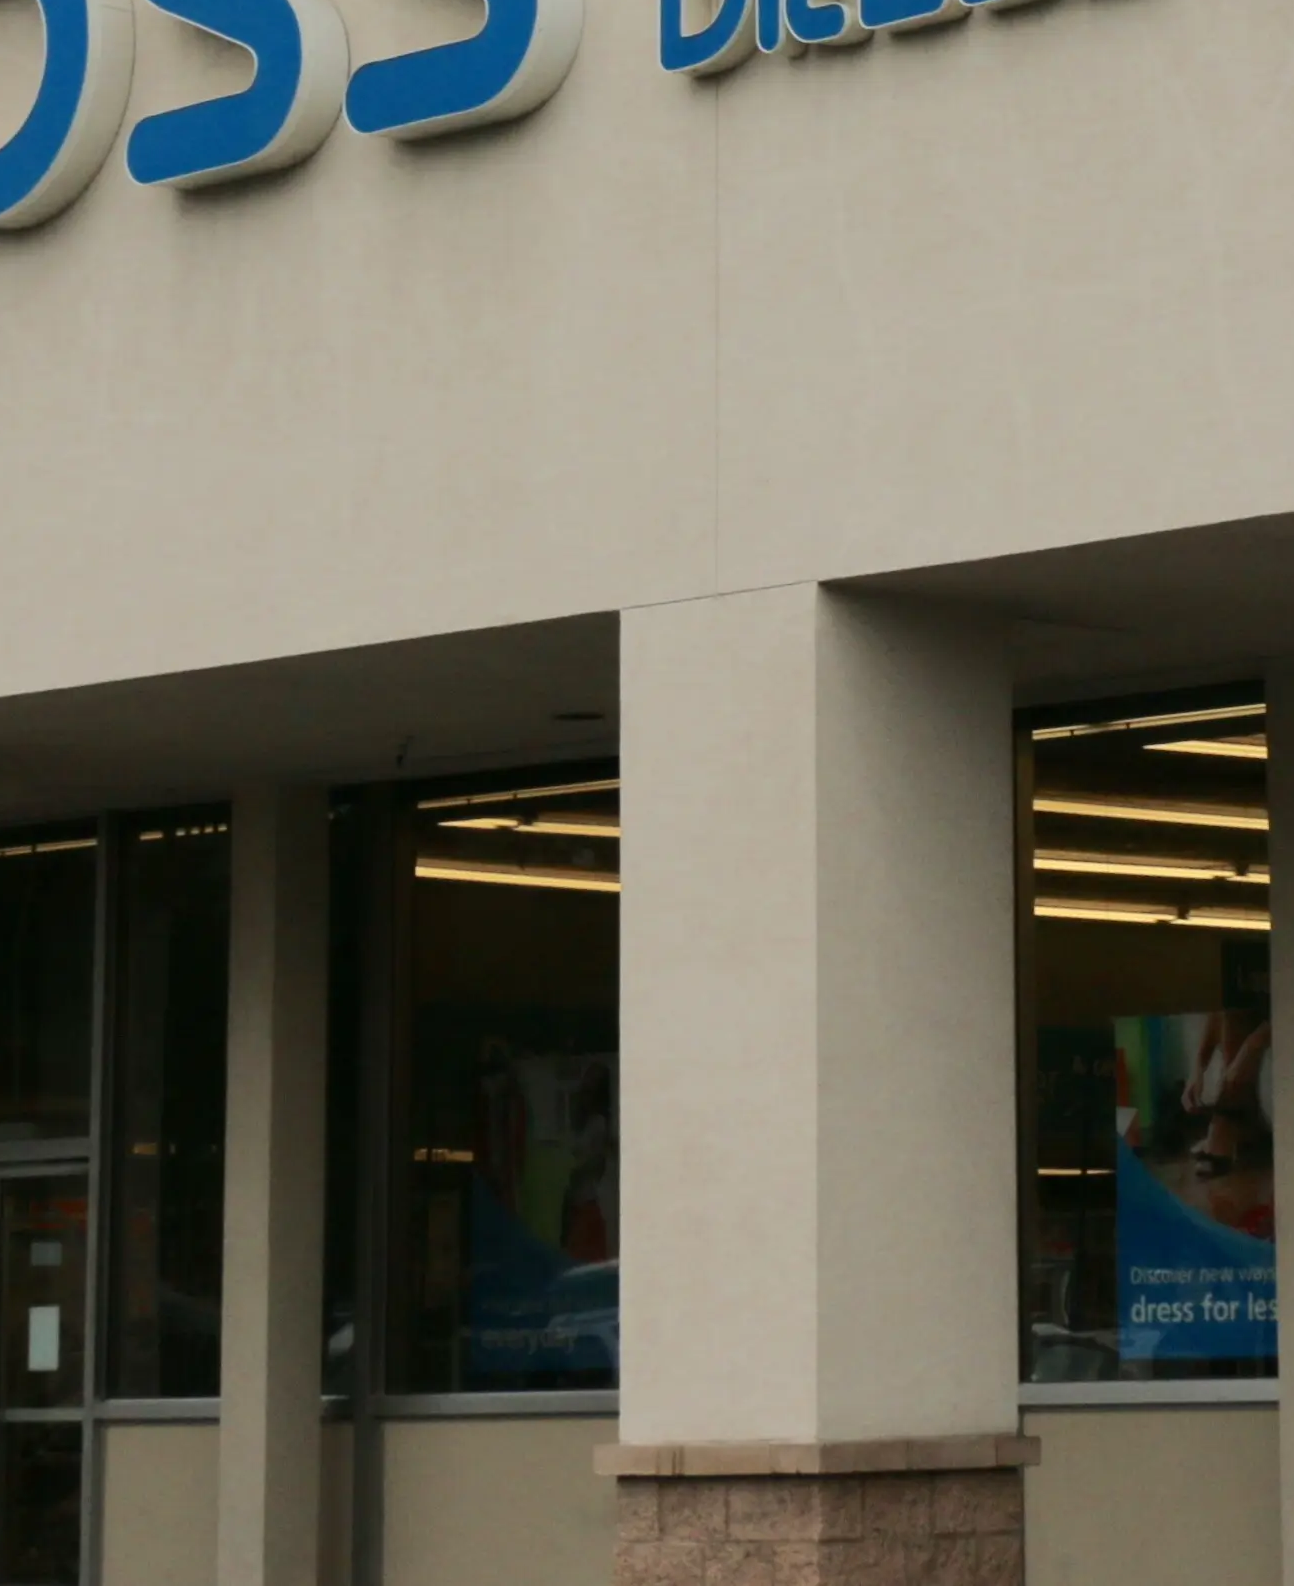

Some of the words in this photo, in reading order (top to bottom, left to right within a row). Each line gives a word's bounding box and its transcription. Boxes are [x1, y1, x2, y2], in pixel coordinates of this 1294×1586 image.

[1130, 1294, 1194, 1323] dress
[1201, 1291, 1239, 1321] for
[1247, 1291, 1277, 1321] les
